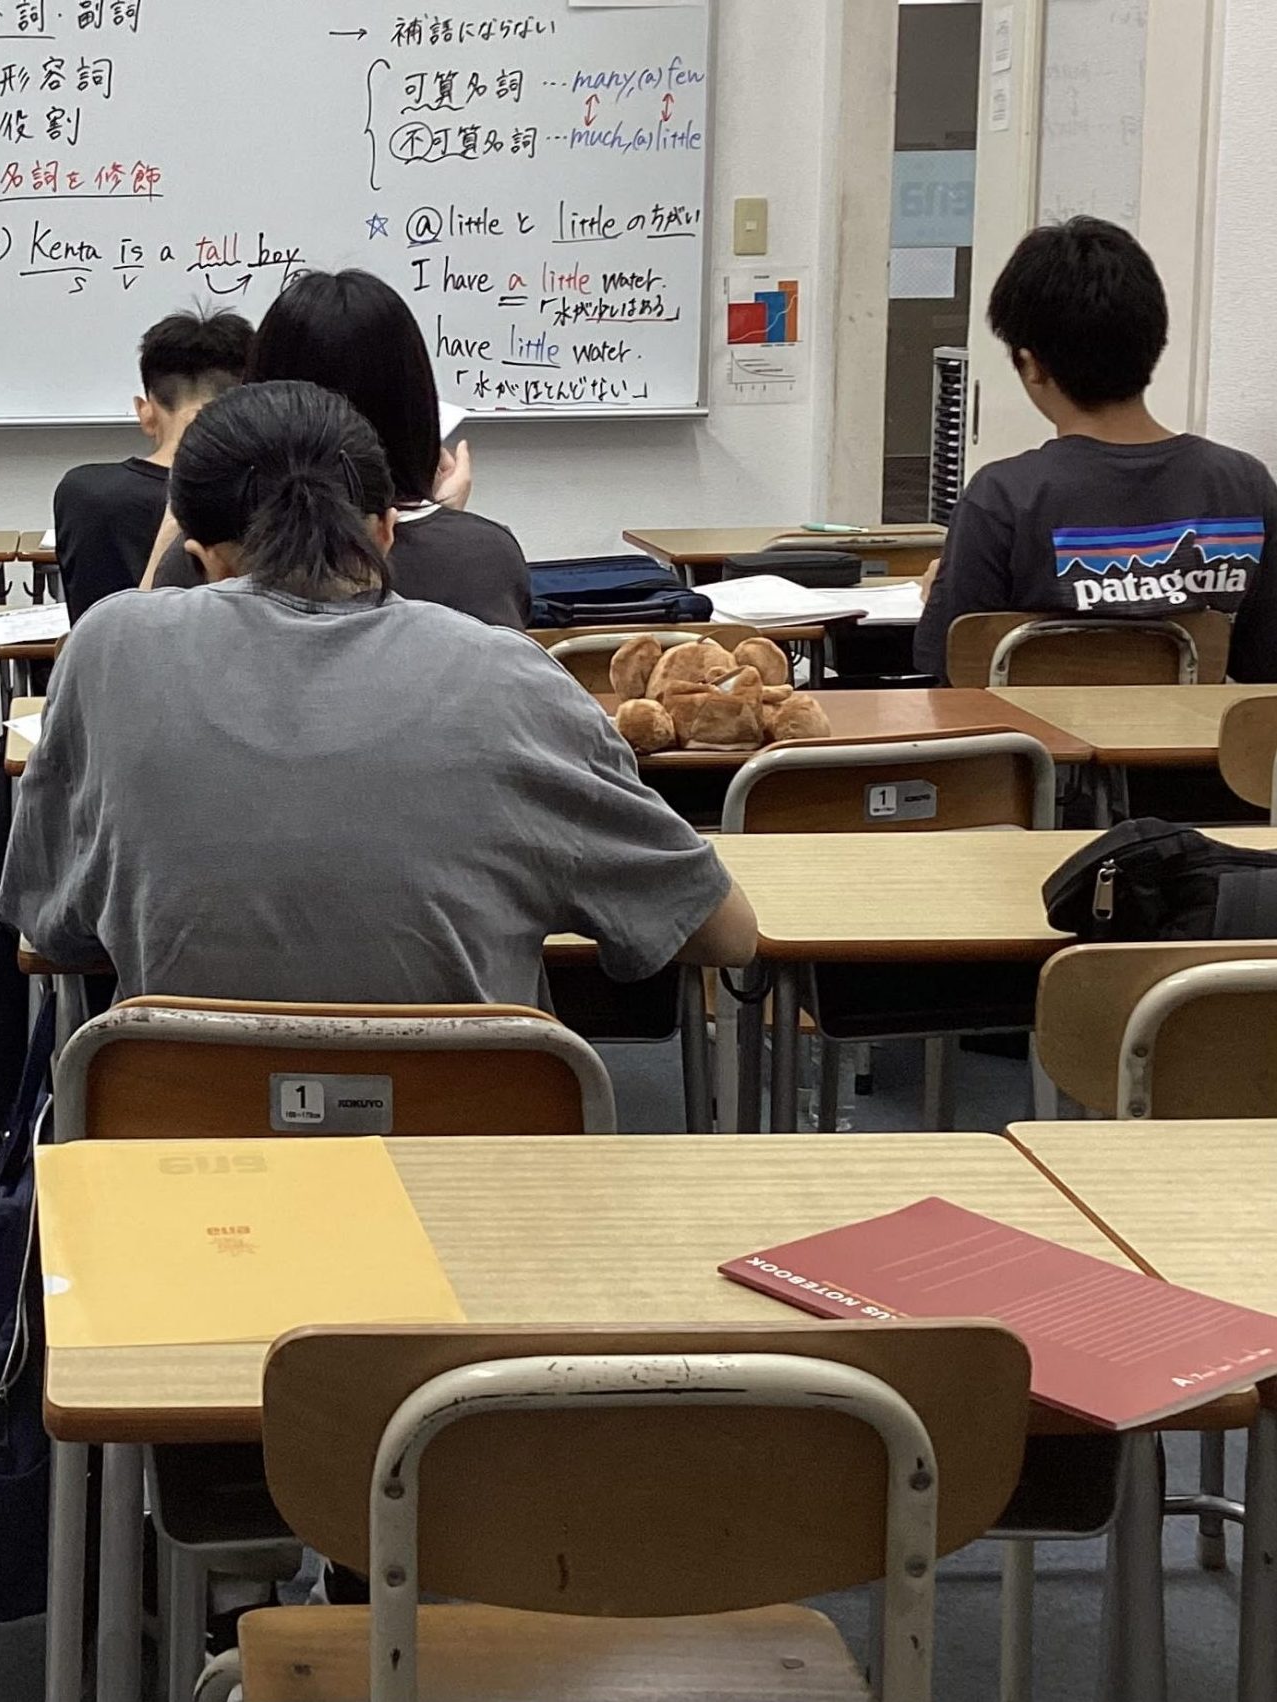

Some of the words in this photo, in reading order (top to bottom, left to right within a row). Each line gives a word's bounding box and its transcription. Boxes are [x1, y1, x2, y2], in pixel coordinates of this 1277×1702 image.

[391, 17, 556, 47] 補語にならない
[0, 56, 113, 99] 形容詞
[404, 69, 523, 104] 可算名詞
[0, 106, 81, 146] 役割
[0, 161, 161, 202] 名詞を修飾
[30, 220, 102, 264] Kenta
[120, 238, 143, 263] is
[160, 247, 175, 261] a
[194, 232, 238, 263] tall
[444, 256, 494, 292] have
[509, 273, 527, 290] a
[542, 261, 592, 295] little
[436, 315, 493, 360] have
[510, 324, 560, 365] little
[295, 1085, 306, 1109] 1
[745, 1257, 860, 1307] NOTEBOOK
[861, 1305, 898, 1320] US
